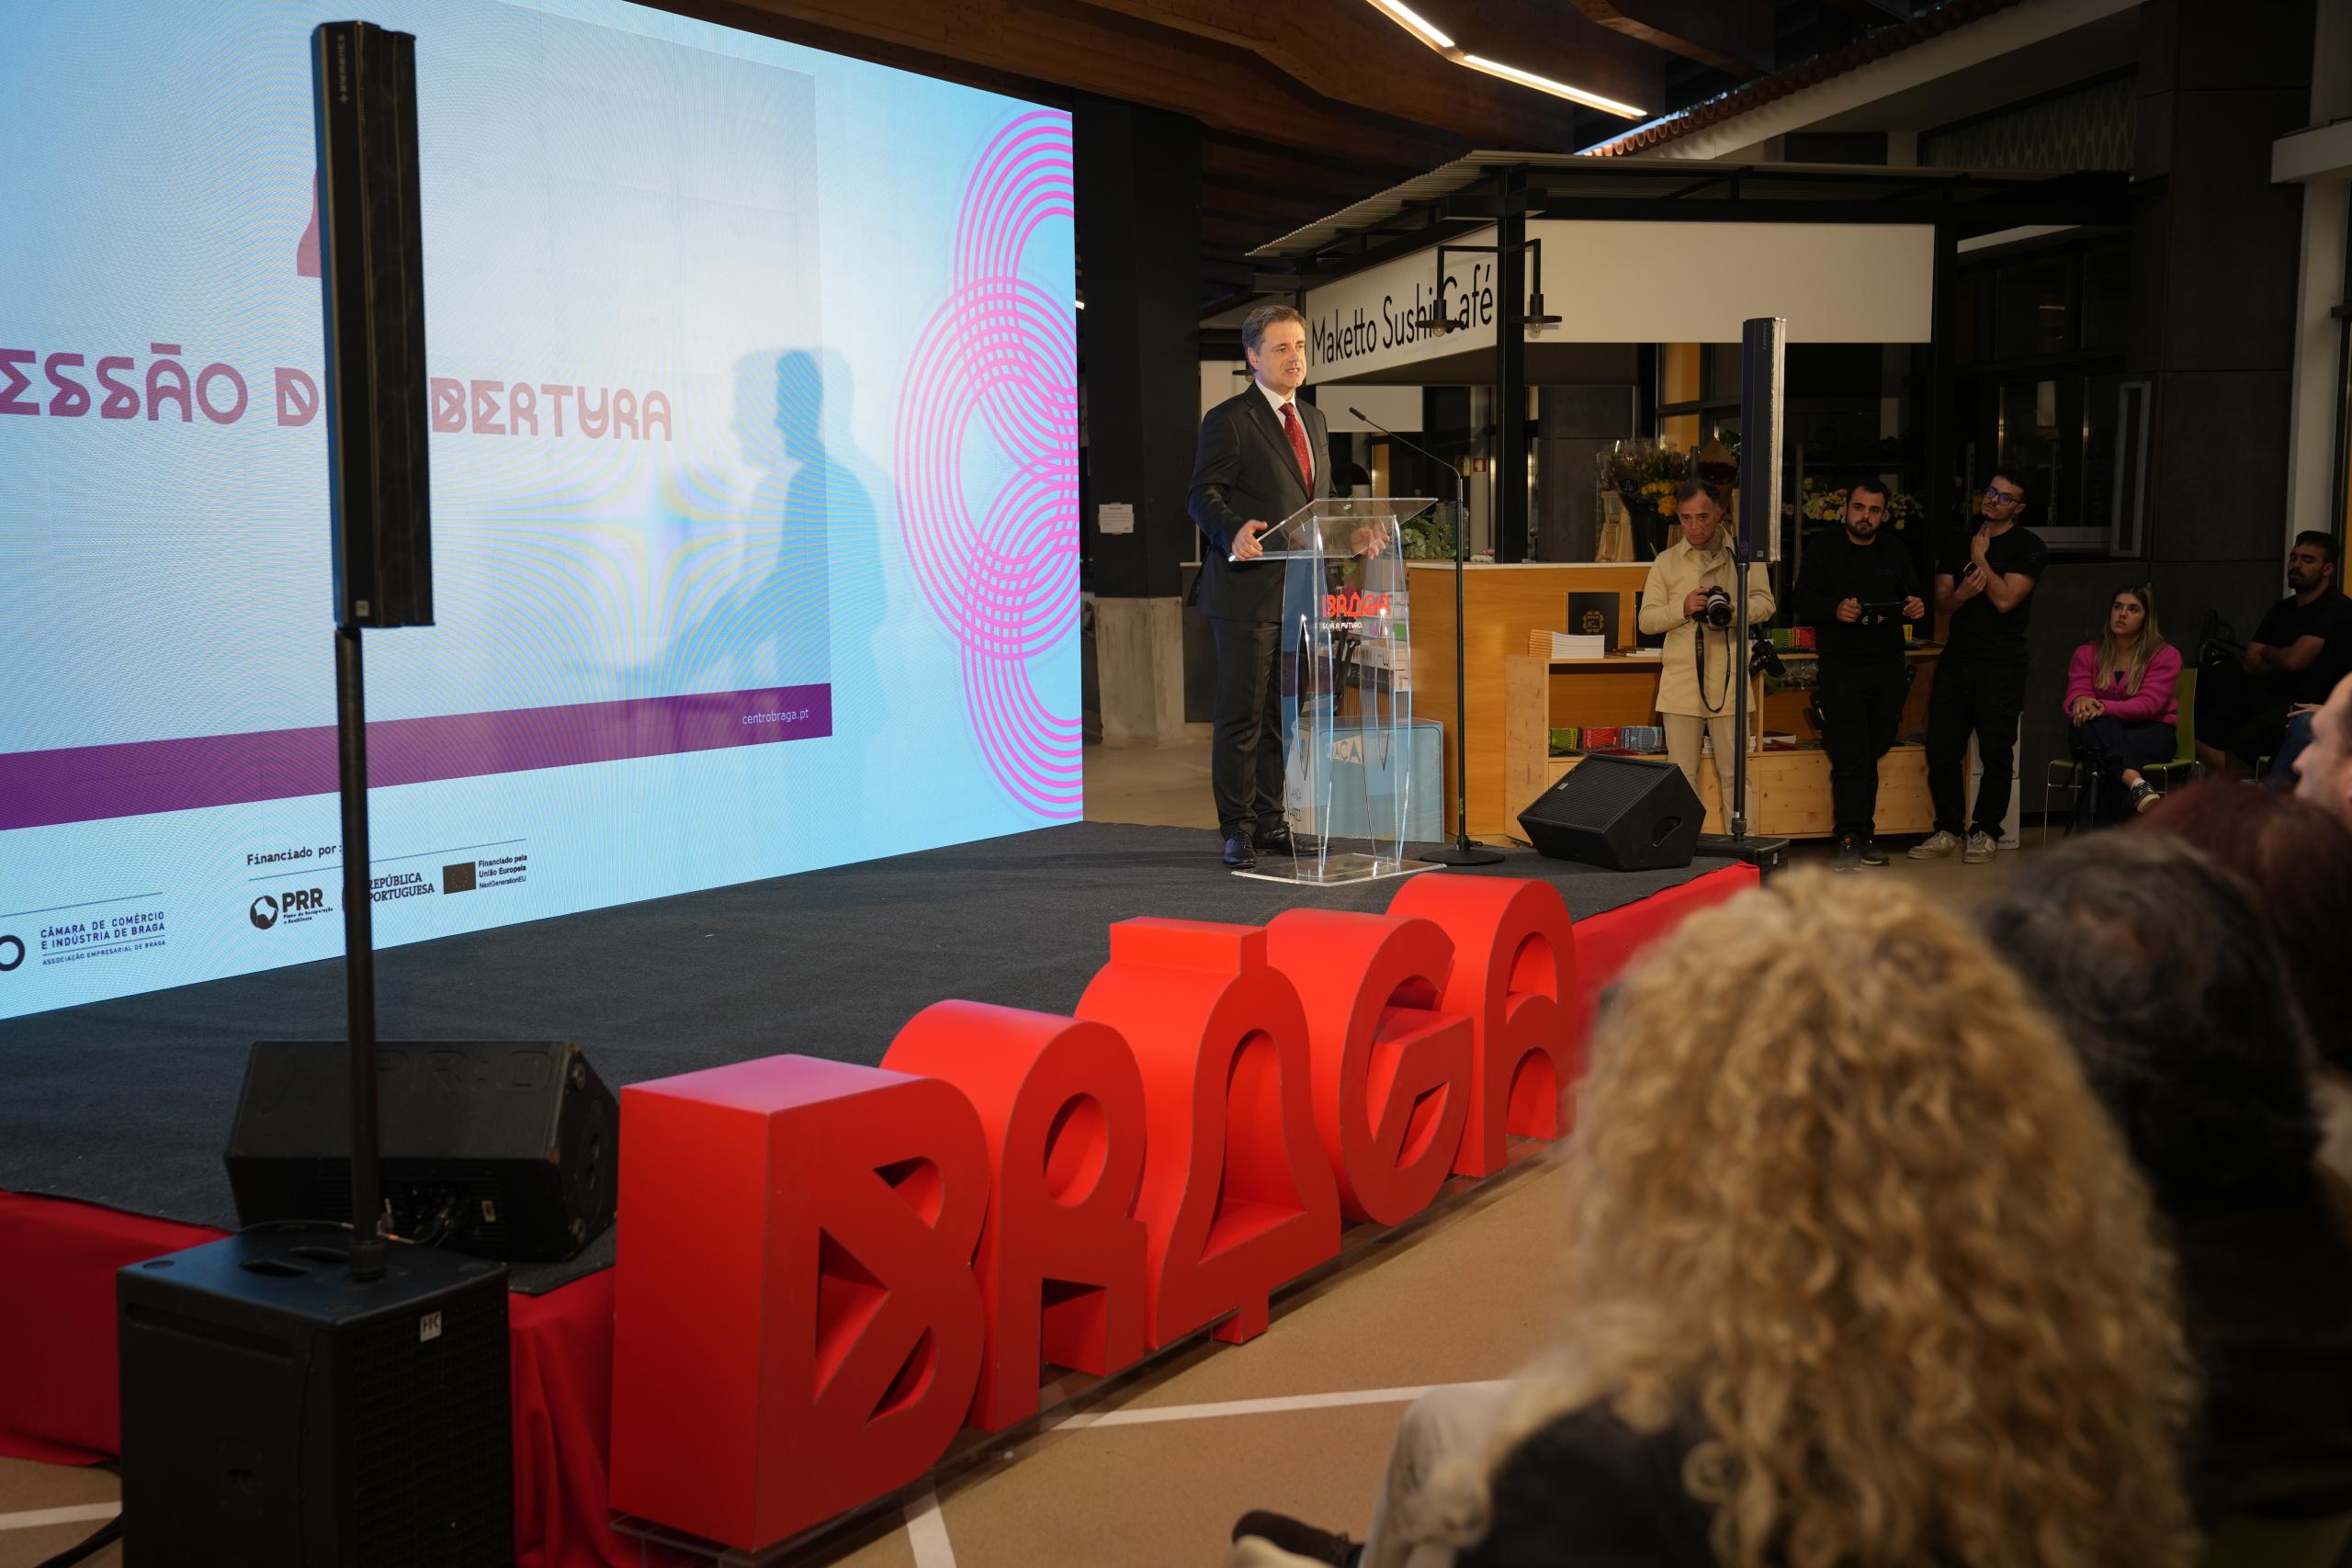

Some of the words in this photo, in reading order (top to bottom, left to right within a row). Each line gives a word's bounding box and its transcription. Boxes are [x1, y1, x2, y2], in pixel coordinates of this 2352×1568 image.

[1312, 307, 1376, 367] Maketto
[1382, 283, 1432, 349] Sushi
[1441, 264, 1493, 334] Café
[275, 367, 320, 427] D
[430, 377, 673, 441] BERTURA
[1322, 592, 1391, 618] BRAGA
[741, 707, 809, 725] centrobraga.pt
[246, 846, 313, 865] Financiado
[318, 844, 343, 858] por:
[478, 856, 514, 868] Financiado
[514, 854, 527, 863] pela
[479, 869, 497, 878] União
[499, 864, 526, 875] Europeia
[281, 887, 323, 913] PRR
[40, 924, 85, 939] CÂMARA
[92, 919, 106, 931] DE
[111, 911, 164, 927] COMÉRCIO
[41, 941, 48, 950] E
[51, 931, 110, 949] INDÚSTRIA
[114, 928, 128, 938] DE
[131, 922, 165, 935] BRAGA
[42, 953, 85, 965] ASSOCIAÇÃO
[86, 947, 131, 958] EMPRESARIAL
[145, 940, 165, 949] BRAGA
[610, 874, 1575, 1553] BRAGA
